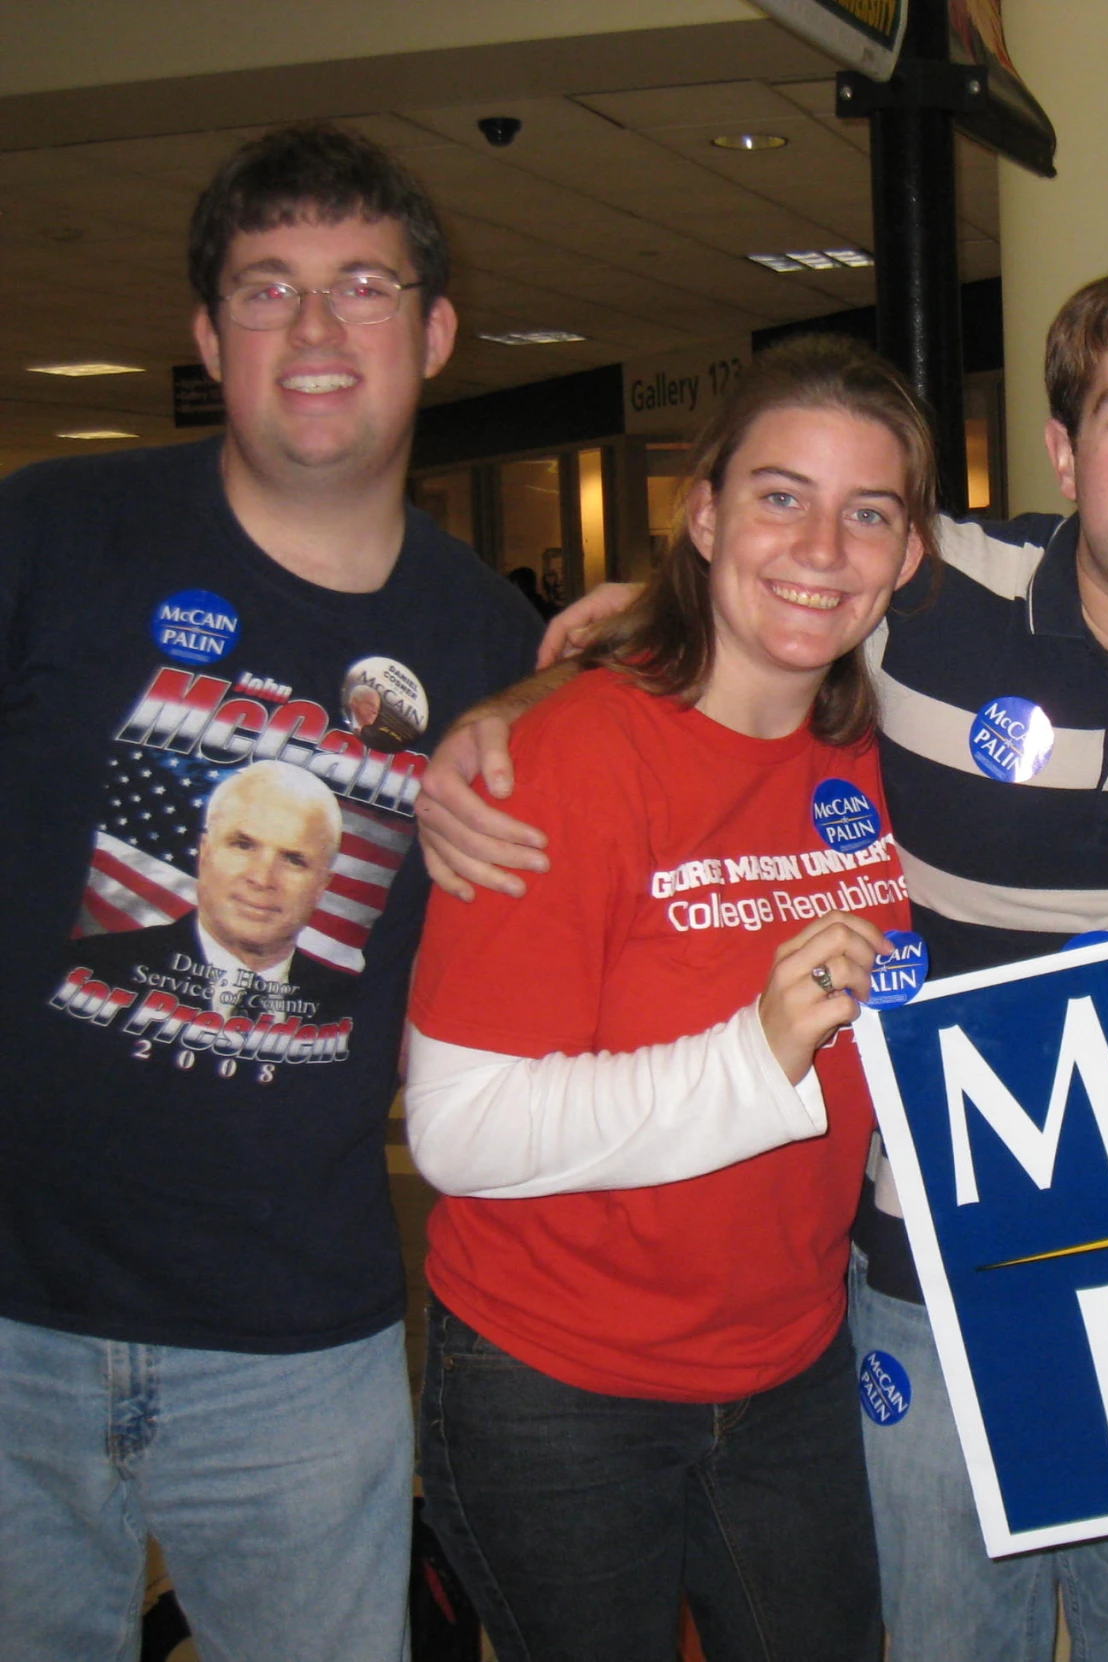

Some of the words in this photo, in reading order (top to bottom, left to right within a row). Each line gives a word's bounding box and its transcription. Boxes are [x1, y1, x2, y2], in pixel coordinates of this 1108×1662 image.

[631, 372, 699, 412] Gallery
[160, 605, 238, 633] McCAIN
[162, 629, 225, 655] PALIN
[236, 671, 294, 704] John
[358, 670, 425, 726] McCAIN
[984, 702, 1030, 741] McC
[115, 666, 431, 818] McCain
[813, 794, 870, 820] McCAIN
[825, 819, 876, 844] PALIN
[724, 855, 803, 884] MASON
[875, 941, 923, 966] CAIN
[133, 964, 215, 1000] Service
[220, 990, 248, 1005] of
[248, 995, 320, 1016] Country
[172, 952, 228, 986] Duty,
[232, 968, 300, 995] Honor
[870, 969, 917, 993] ALIN
[50, 966, 139, 1028] for
[123, 989, 354, 1064] President
[861, 1371, 891, 1422] PALIN
[868, 1353, 909, 1414] McCAIN
